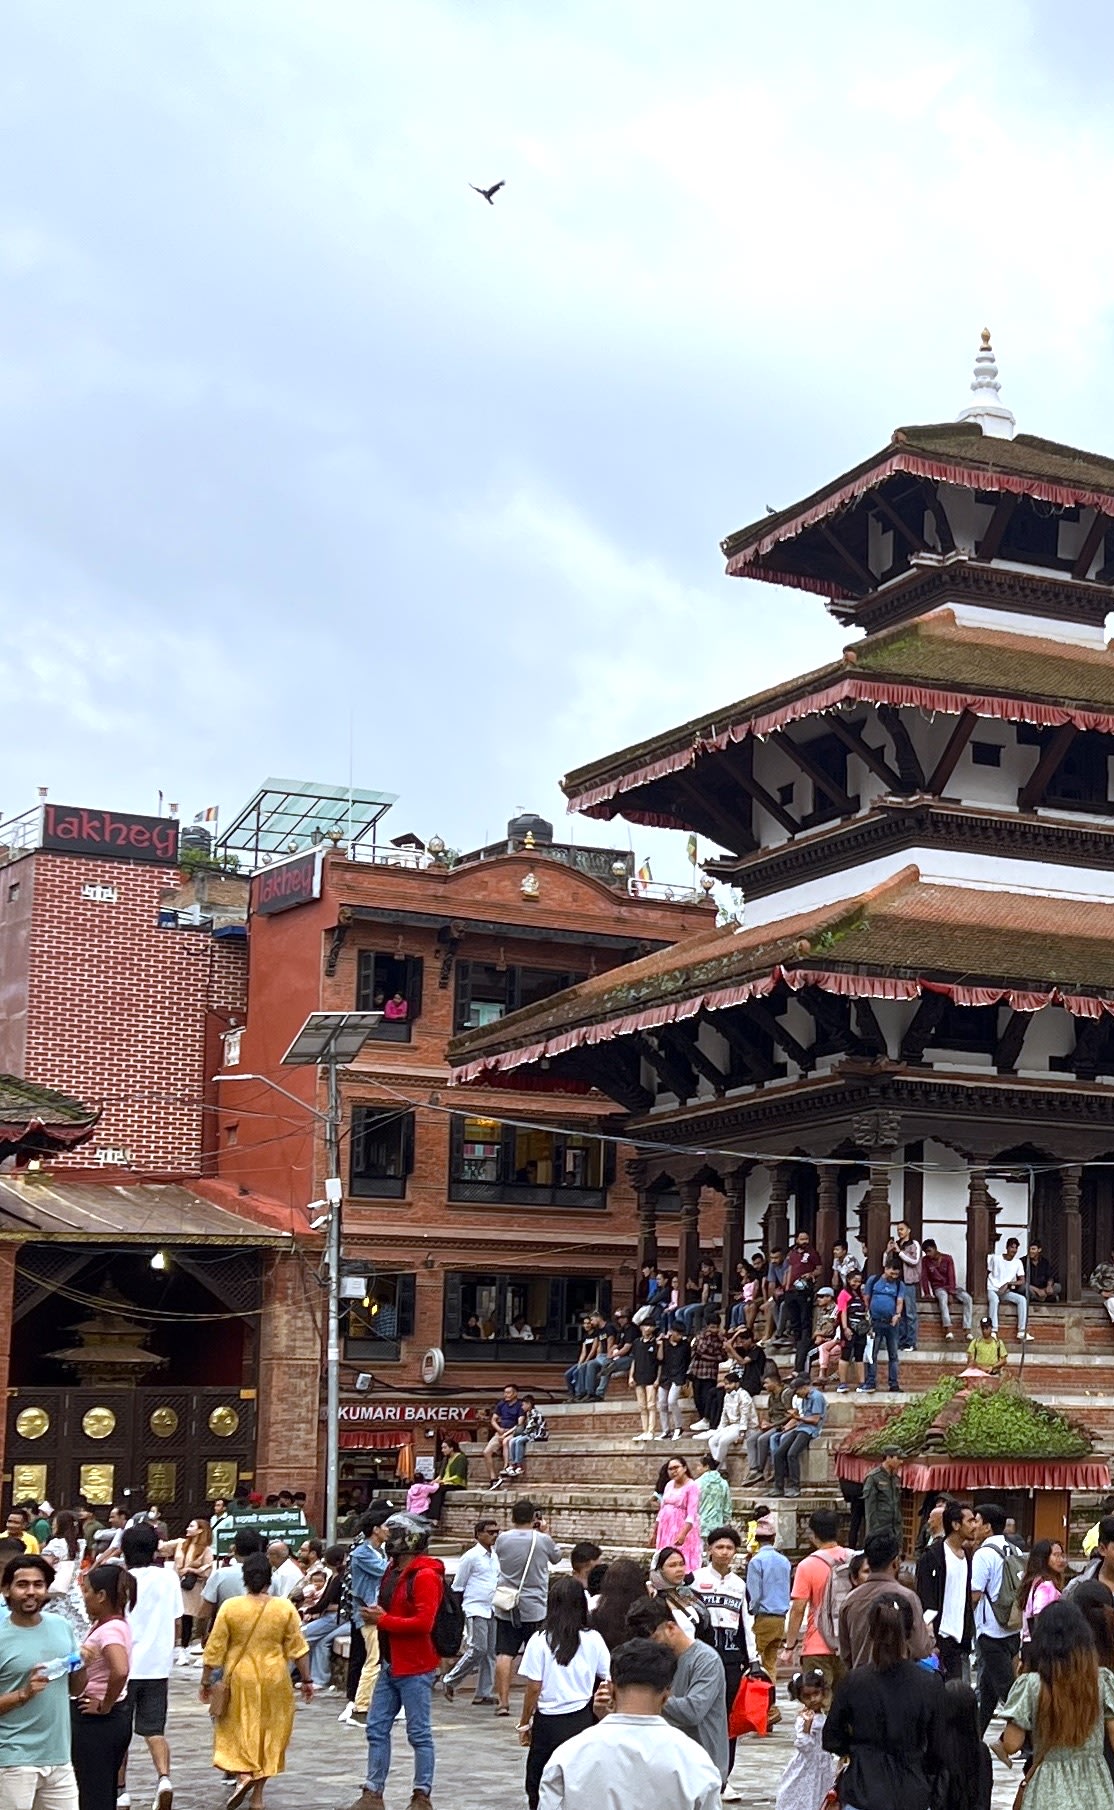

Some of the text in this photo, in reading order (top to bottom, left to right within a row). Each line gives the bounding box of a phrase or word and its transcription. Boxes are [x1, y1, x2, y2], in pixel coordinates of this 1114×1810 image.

[45, 806, 177, 858] lakhey
[259, 864, 312, 903] lakhey
[337, 1406, 470, 1420] KUMARI BAKERY
